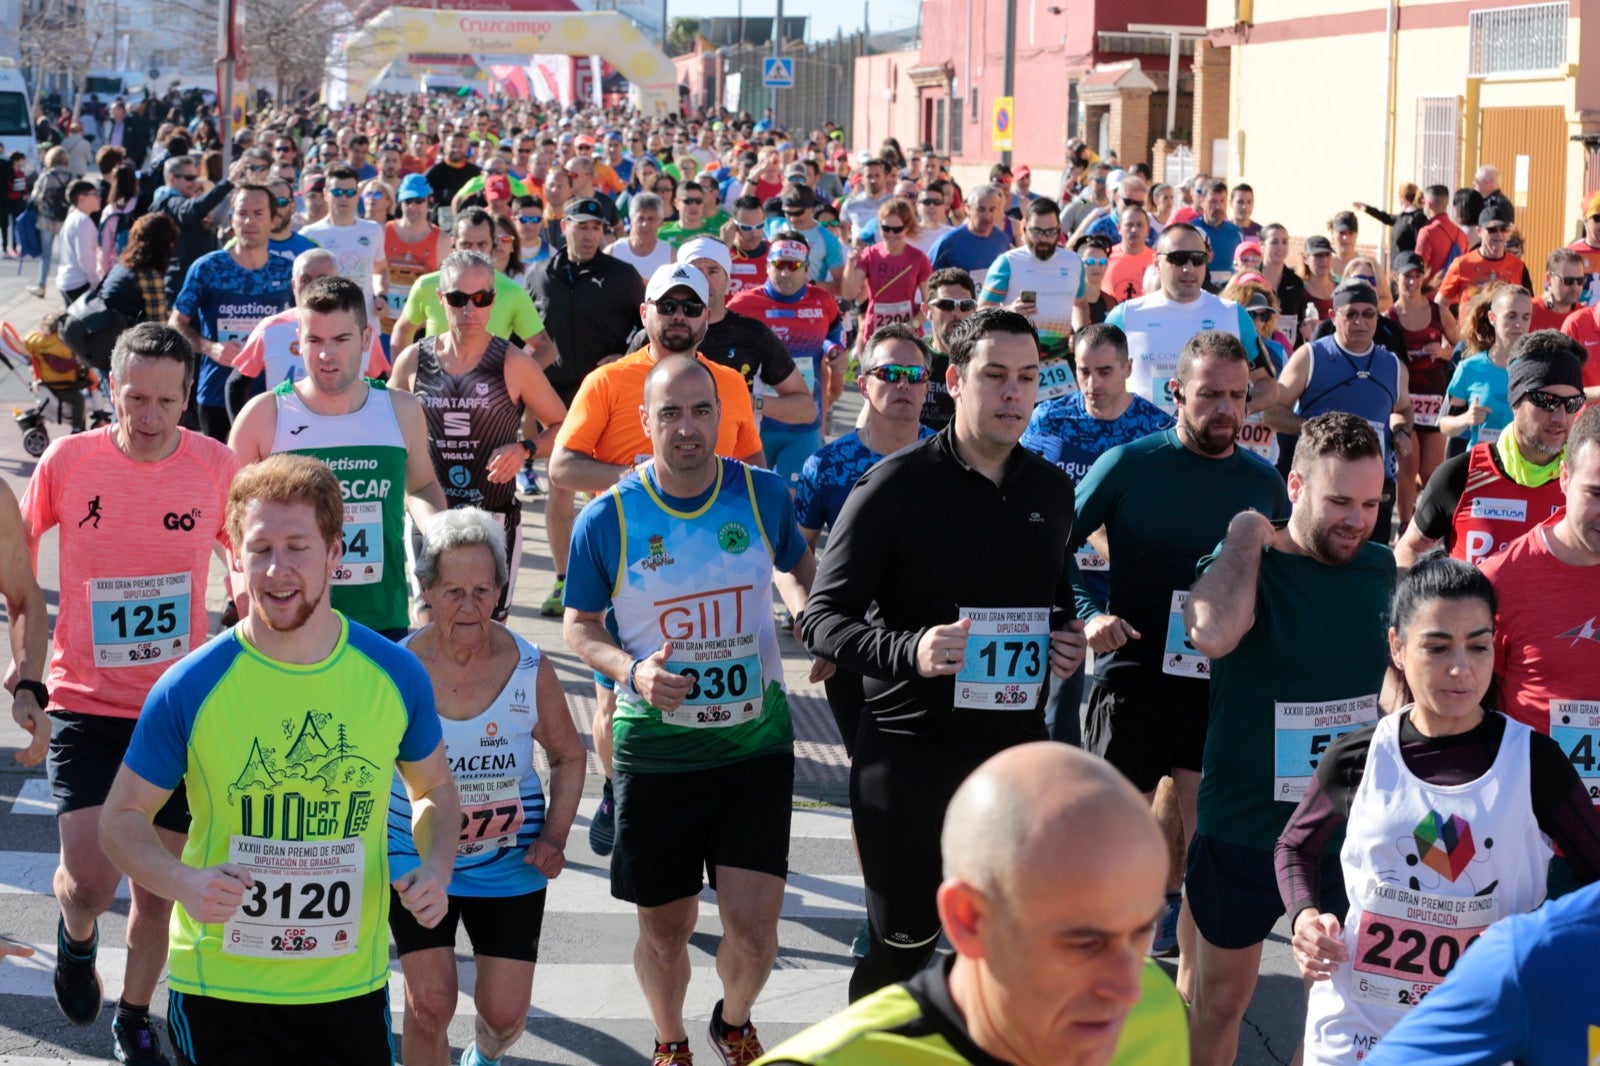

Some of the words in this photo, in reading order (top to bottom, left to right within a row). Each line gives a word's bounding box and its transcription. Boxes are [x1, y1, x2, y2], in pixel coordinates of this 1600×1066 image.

[460, 17, 551, 34] Cruzcampo
[219, 302, 278, 318] agustinos
[877, 313, 910, 326] 2204
[426, 398, 490, 408] TRIATARFE
[1412, 401, 1440, 413] 272
[1235, 425, 1270, 443] 007
[436, 440, 480, 448] SEAT
[442, 452, 474, 460] VIGILSA
[164, 513, 195, 531] GO
[192, 508, 201, 518] fit
[97, 580, 113, 589] XXXIII
[115, 579, 131, 589] GRAN
[133, 578, 155, 587] PREMIO
[157, 577, 164, 586] DE
[166, 575, 185, 585] FONDO
[111, 603, 176, 638] 125
[968, 612, 987, 621] XXXIII
[989, 612, 1004, 620] GRAN
[1007, 612, 1026, 621] PREMIO
[1027, 612, 1033, 620] DE
[686, 639, 703, 651] GRAN
[705, 638, 727, 649] PREMIO
[729, 637, 736, 647] DE
[737, 635, 753, 645] FONDO
[695, 650, 731, 661] DIPUTACIÓN
[980, 641, 1040, 676] 173
[1284, 706, 1302, 716] XXXIII
[1305, 705, 1323, 716] GRAN
[1325, 702, 1347, 715] PREMIO
[1349, 702, 1356, 712] DE
[1357, 699, 1373, 710] FONDO
[1559, 704, 1578, 713] XXXIII
[1580, 705, 1599, 714] GRAN
[1314, 715, 1351, 727] DIPUTACIÓN
[1570, 735, 1600, 771] 4
[460, 782, 484, 792] PREMIO
[487, 781, 494, 791] DE
[496, 779, 515, 790] FONDO
[238, 842, 260, 854] XXXIII
[263, 844, 286, 855] GRAN
[288, 845, 317, 857] PREMIO
[320, 845, 329, 855] DE
[331, 843, 355, 854] FONDO
[254, 857, 296, 867] DIPUTACIÓN
[300, 858, 308, 867] DE
[310, 857, 340, 867] GRANADA
[242, 880, 349, 919] 3120
[1399, 891, 1419, 906] GRAN
[1422, 899, 1453, 911] PREMIO
[1456, 901, 1466, 912] DE
[1468, 898, 1492, 912] FONDO
[1407, 908, 1458, 926] DIPUTACIÓN
[1362, 922, 1480, 977] 220
